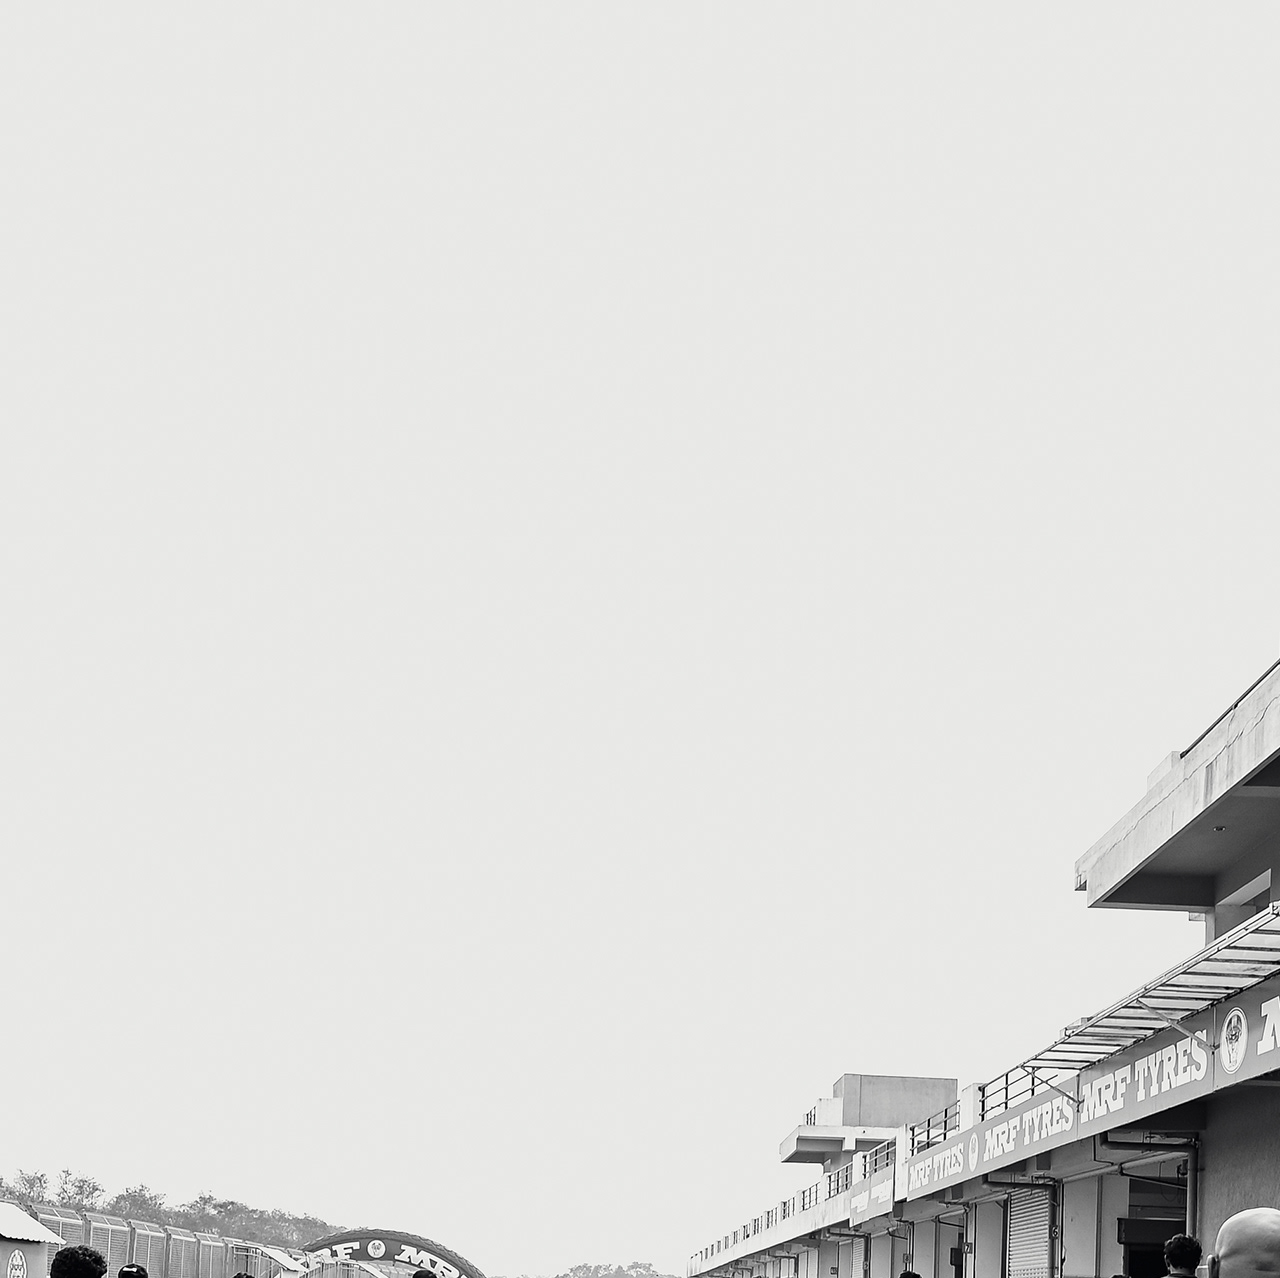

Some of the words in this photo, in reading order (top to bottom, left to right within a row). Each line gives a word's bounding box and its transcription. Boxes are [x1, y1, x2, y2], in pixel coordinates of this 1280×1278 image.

[1080, 1064, 1132, 1124] MRF
[1134, 1029, 1208, 1102] TYRES
[983, 1115, 1021, 1162] MRF
[1022, 1091, 1075, 1147] TYRES
[908, 1159, 933, 1191] MRF
[933, 1142, 965, 1181] TYRES
[1052, 1226, 1059, 1237] 6
